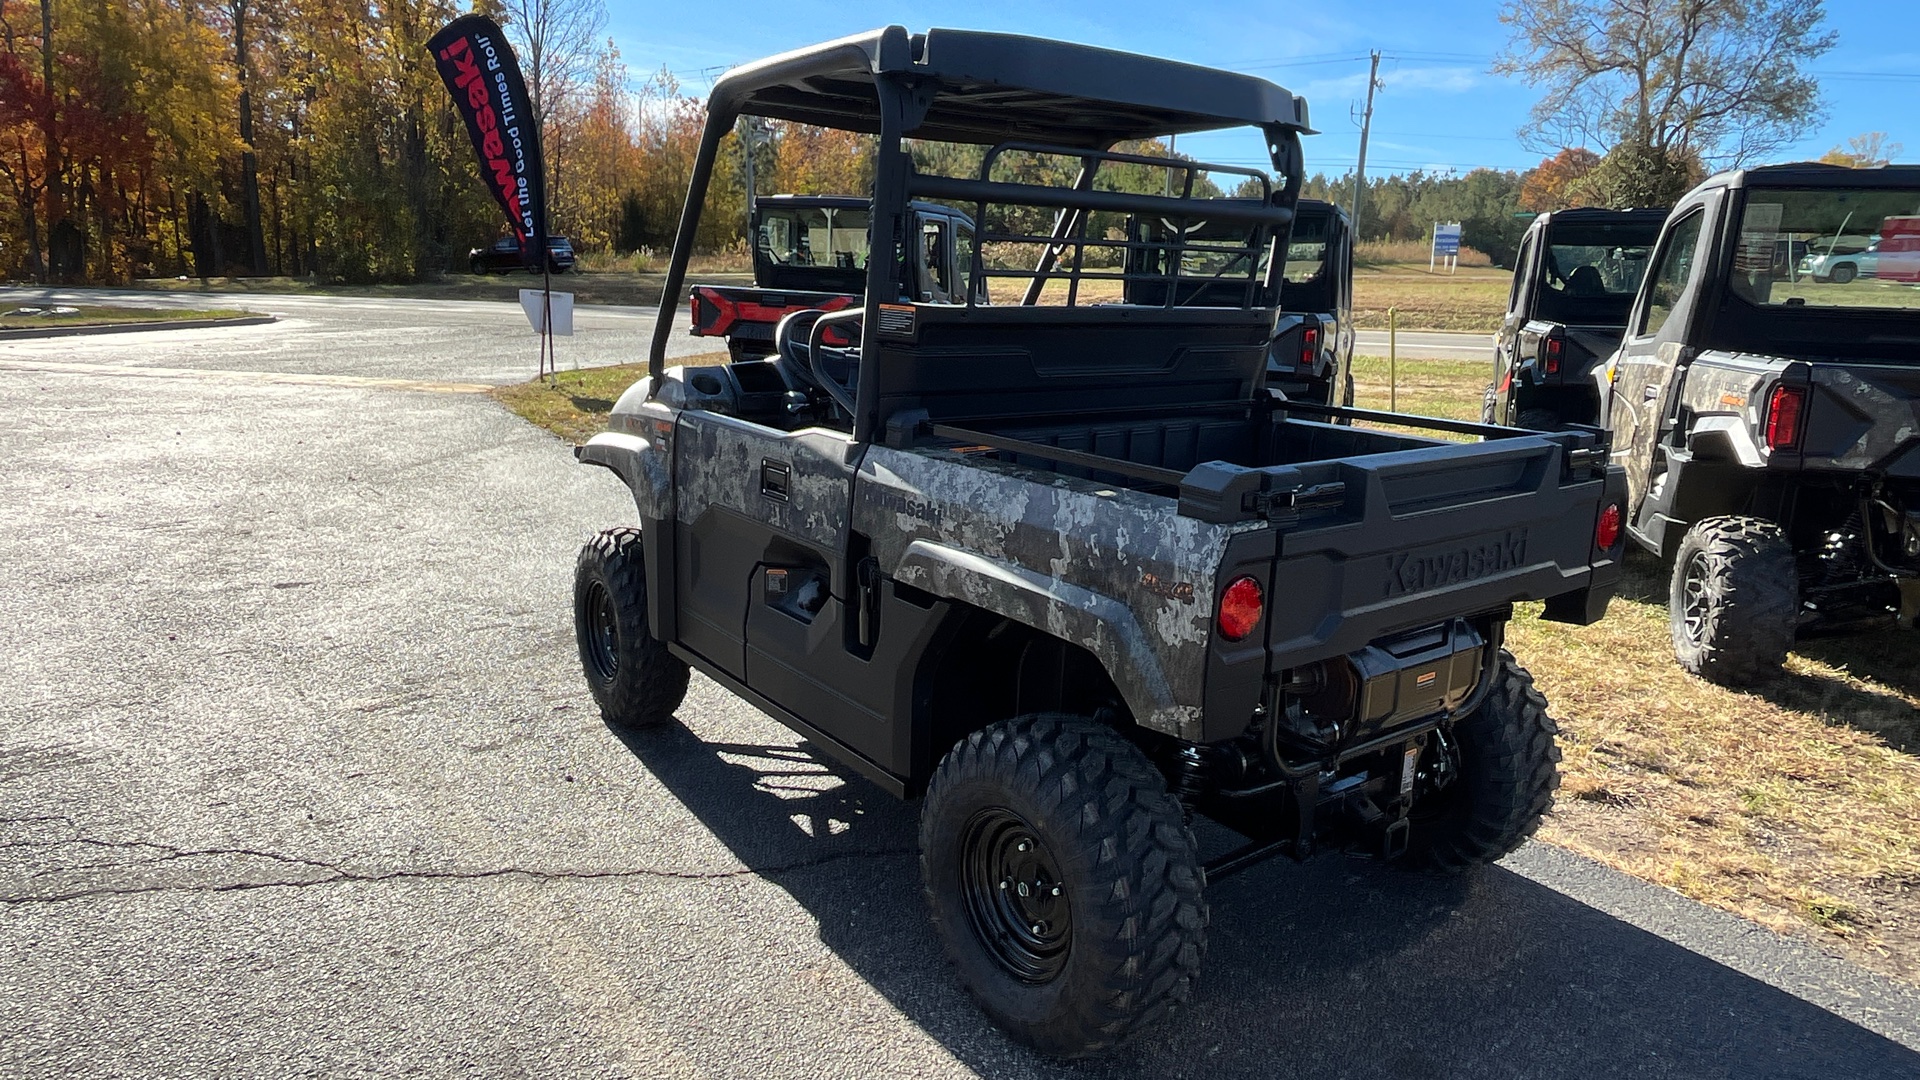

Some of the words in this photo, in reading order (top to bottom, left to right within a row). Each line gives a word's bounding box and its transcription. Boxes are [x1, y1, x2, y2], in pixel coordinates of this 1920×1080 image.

[494, 73, 516, 126] Times
[440, 36, 526, 253] awasaki
[507, 127, 525, 173] Good
[517, 177, 530, 207] the
[521, 209, 535, 238] Let
[1384, 528, 1529, 600] Kawasaki
